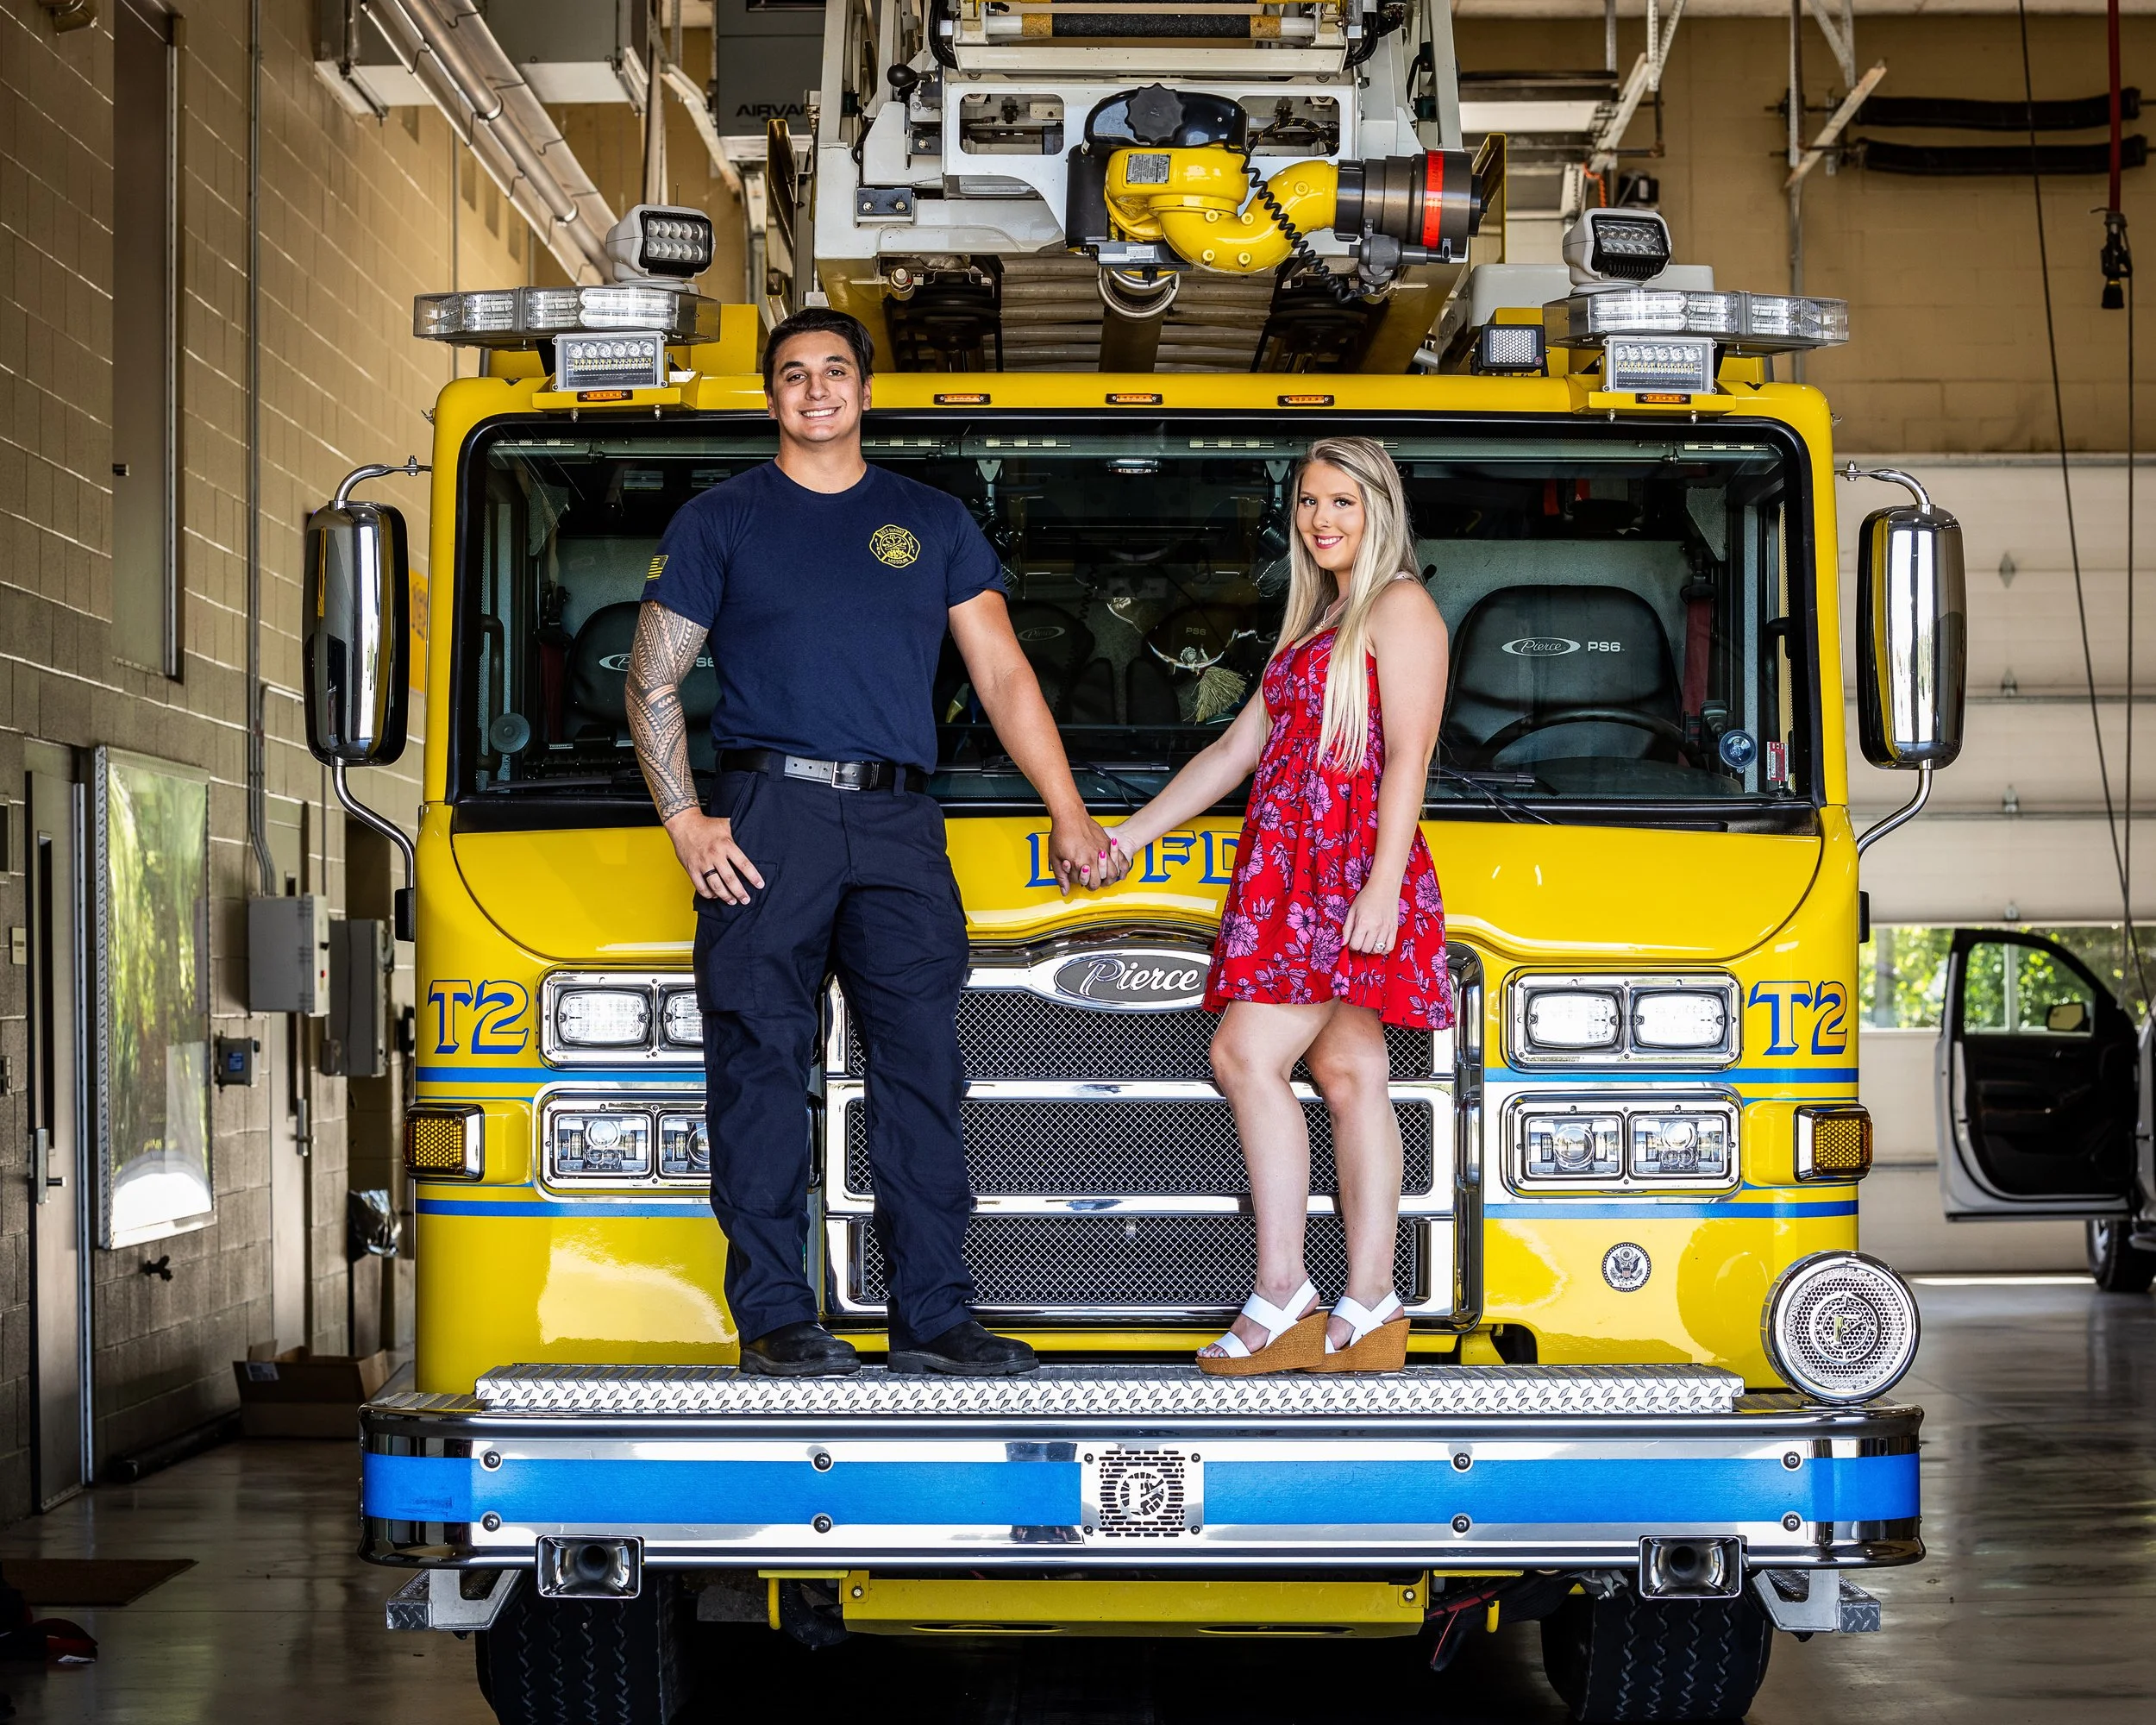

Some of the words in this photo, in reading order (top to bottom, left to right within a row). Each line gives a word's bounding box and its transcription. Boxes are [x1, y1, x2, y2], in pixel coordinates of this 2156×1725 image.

[1520, 640, 1563, 653] Pierce
[1588, 641, 1621, 652] PS6
[1080, 958, 1202, 996] Pierce
[427, 979, 529, 1054] T2
[1747, 980, 1847, 1056] T2
